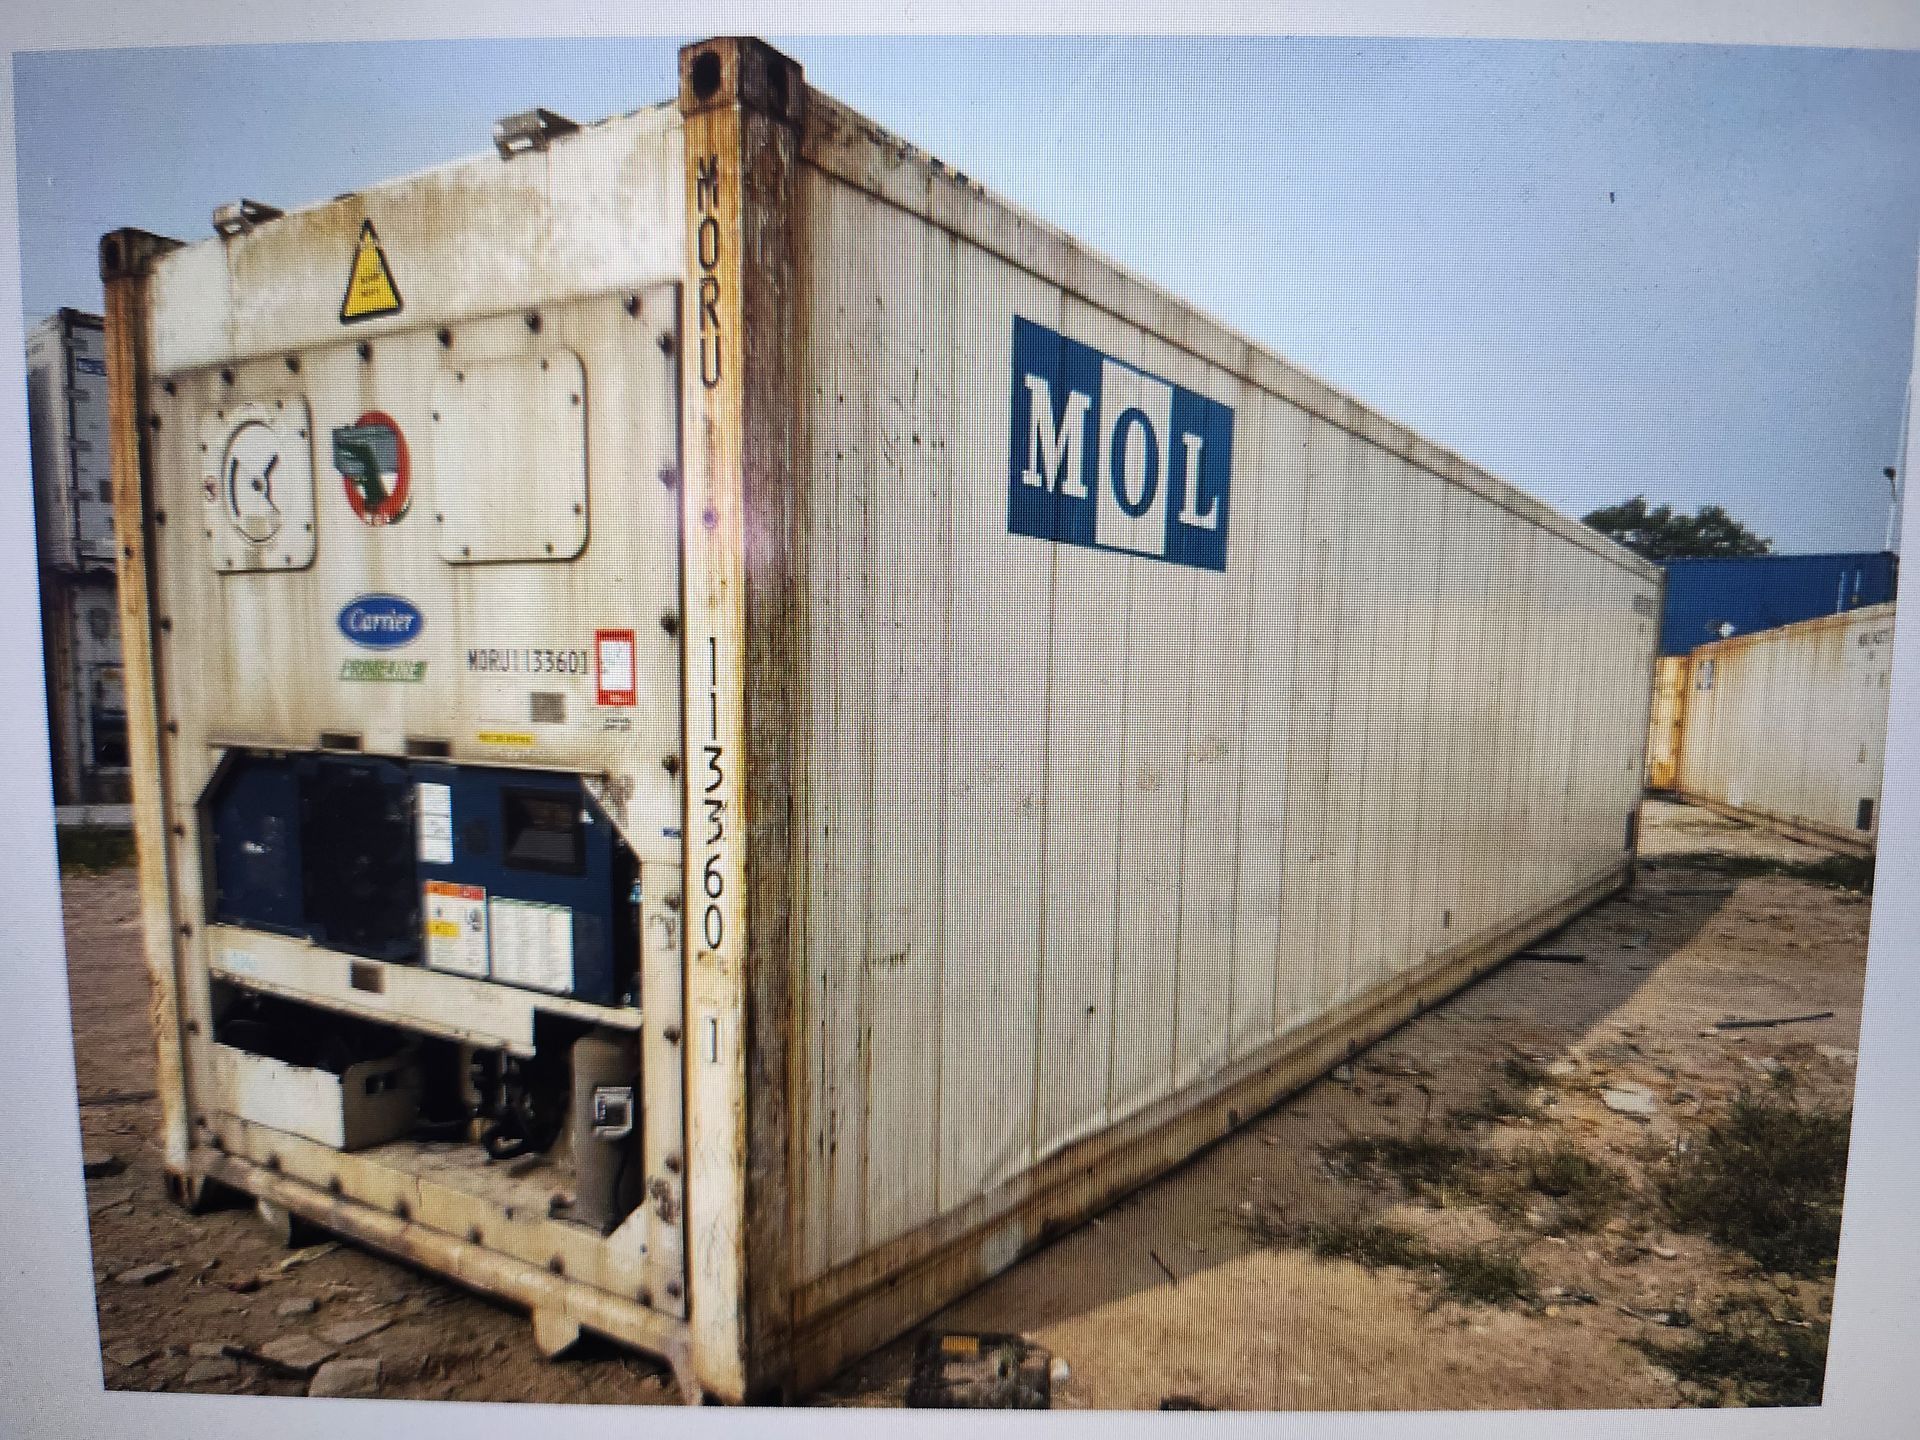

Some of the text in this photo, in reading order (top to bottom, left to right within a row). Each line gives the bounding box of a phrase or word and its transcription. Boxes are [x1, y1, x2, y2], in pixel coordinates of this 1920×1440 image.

[1021, 372, 1220, 531] MOL
[350, 607, 416, 632] Carrier
[697, 153, 724, 1064] MORU 113360 1
